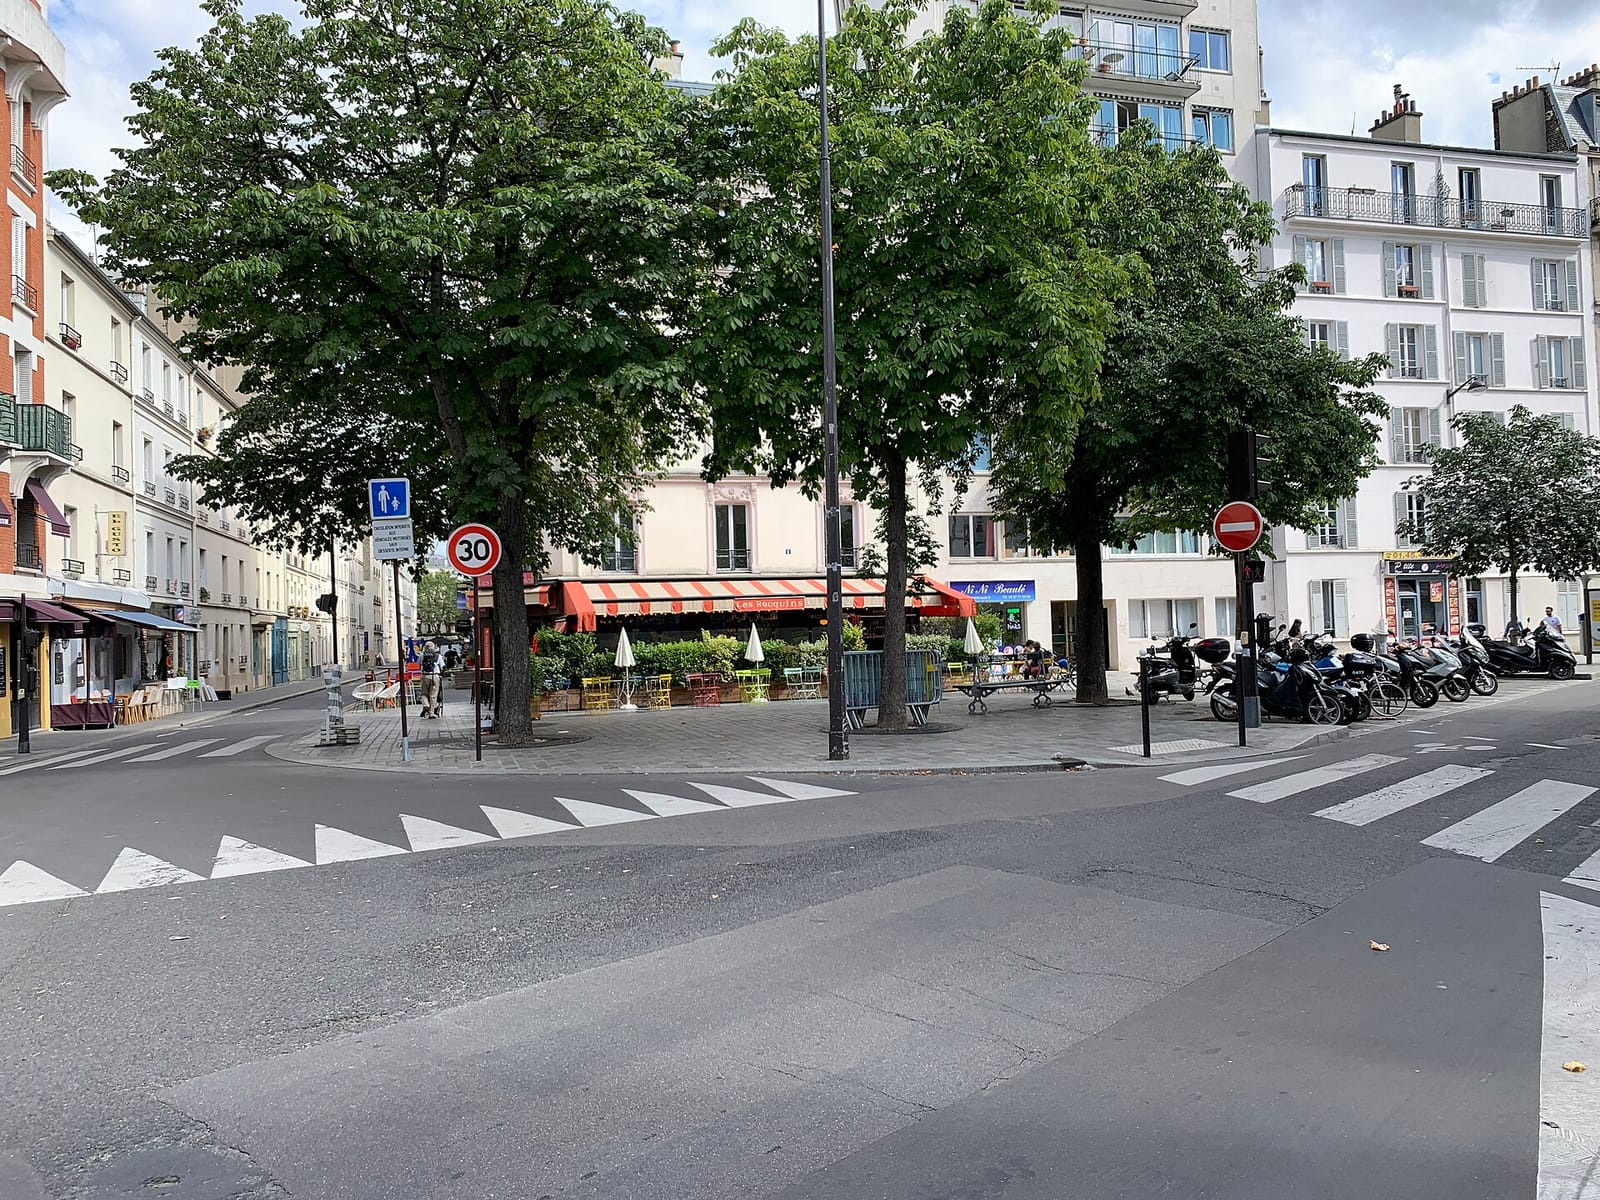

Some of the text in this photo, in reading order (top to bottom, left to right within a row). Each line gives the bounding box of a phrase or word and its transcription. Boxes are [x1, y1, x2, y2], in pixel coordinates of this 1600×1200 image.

[458, 539, 490, 561] 30
[736, 599, 804, 609] Les Rouquins
